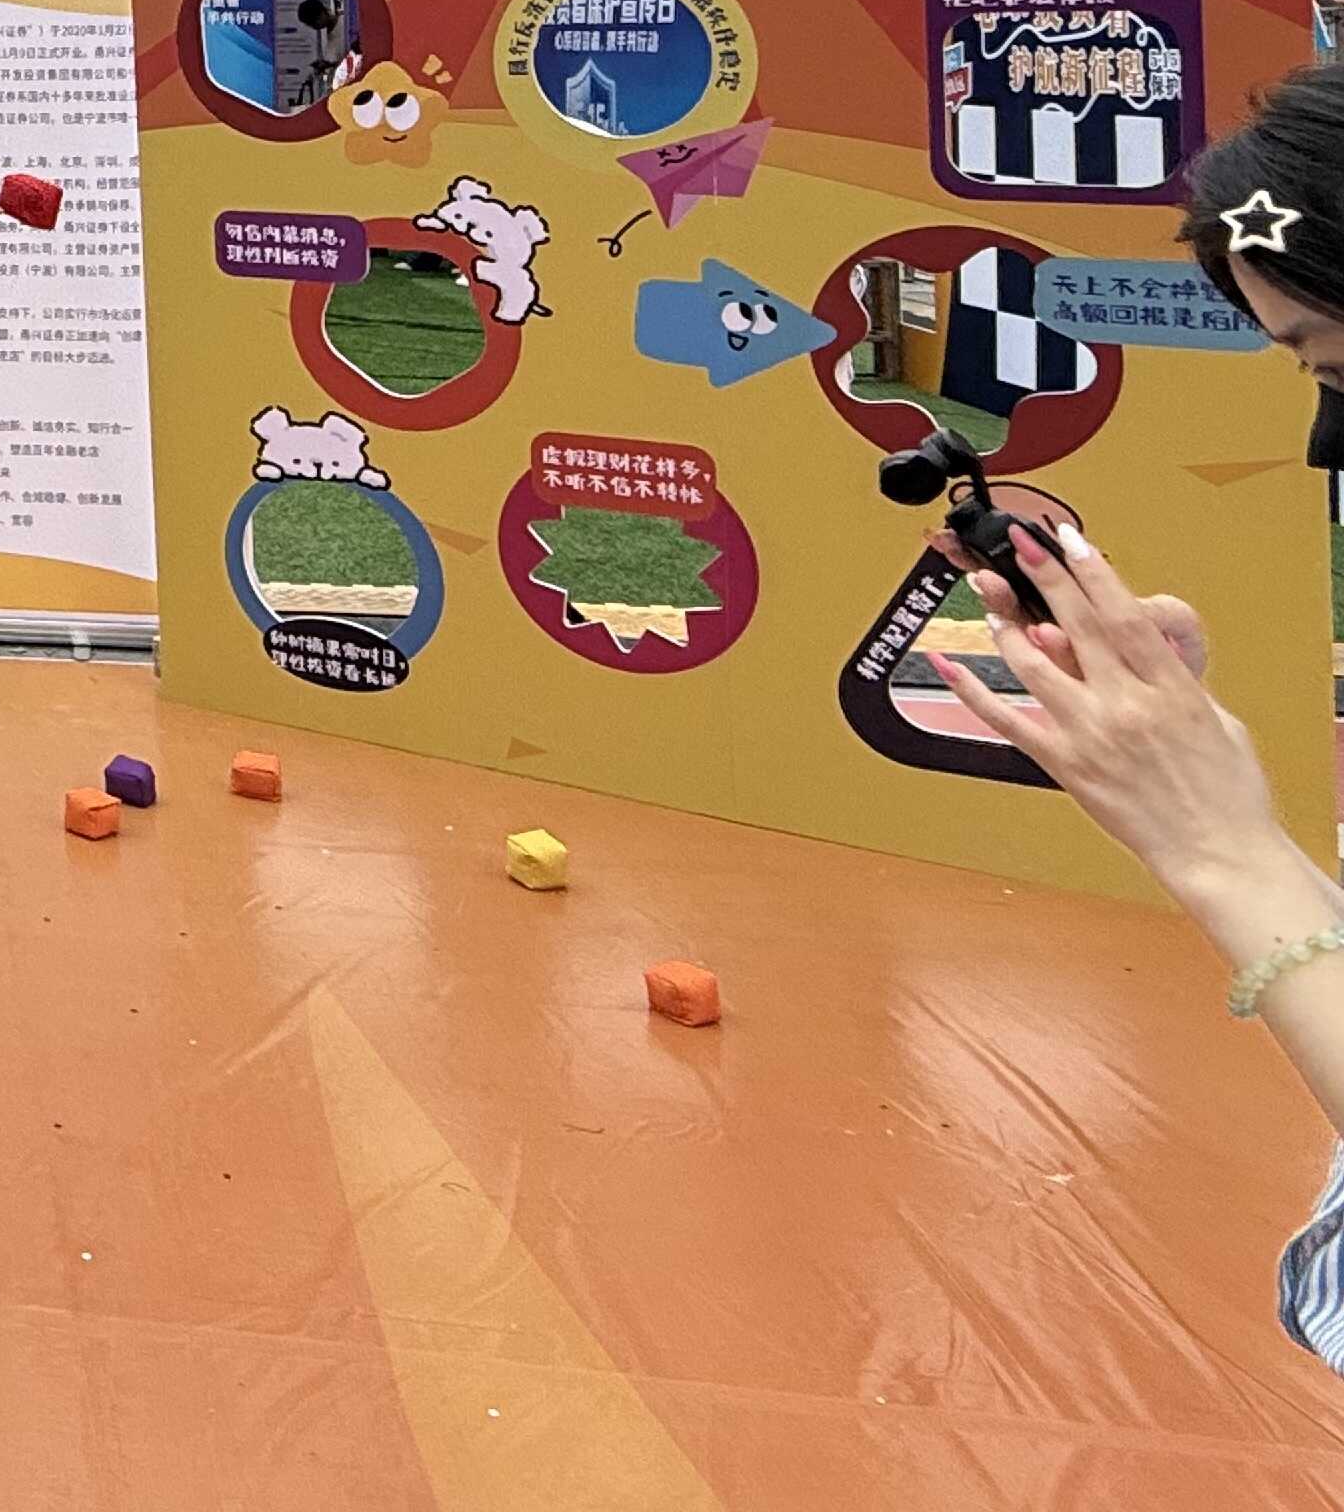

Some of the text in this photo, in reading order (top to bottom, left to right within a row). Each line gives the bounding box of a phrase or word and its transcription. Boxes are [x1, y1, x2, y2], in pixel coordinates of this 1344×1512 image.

[1008, 44, 1146, 97] 护航新征程
[542, 445, 712, 484] 虚假理财花样多，
